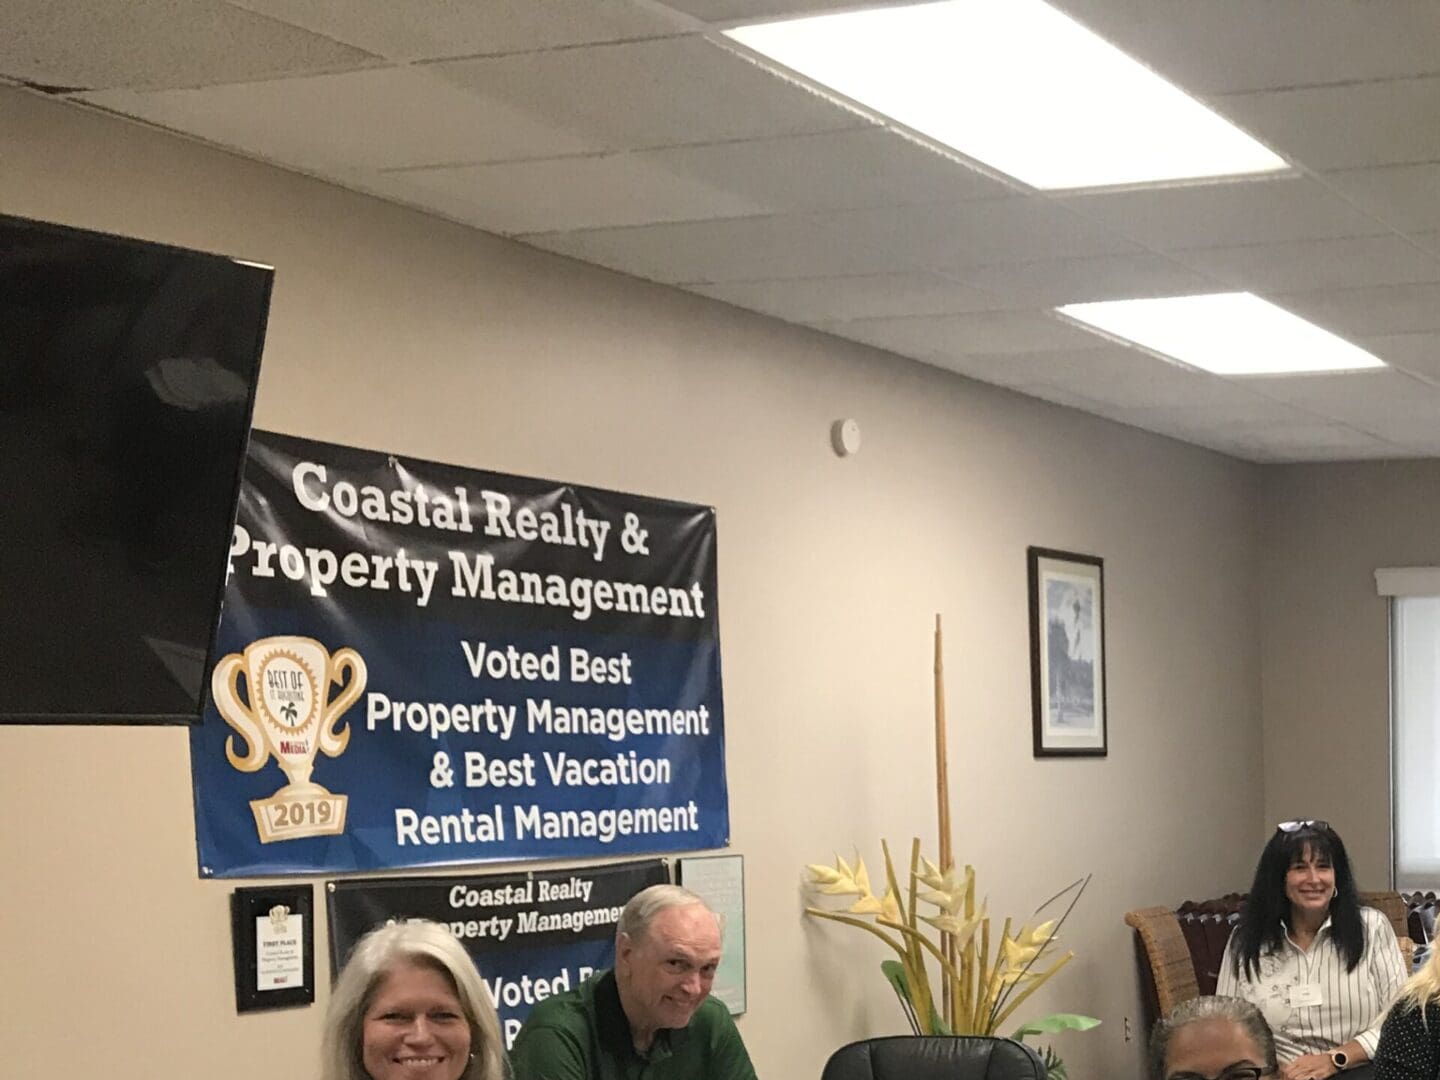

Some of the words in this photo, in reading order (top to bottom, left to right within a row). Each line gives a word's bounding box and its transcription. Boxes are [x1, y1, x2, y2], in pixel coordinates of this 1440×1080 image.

[292, 461, 474, 533] Coastal
[481, 489, 611, 562] Realty
[621, 512, 650, 556] &
[227, 524, 439, 607] Property
[448, 550, 705, 621] Management
[267, 669, 288, 689] BEST
[290, 670, 303, 690] OF
[460, 640, 560, 682] Voted
[570, 648, 632, 685] Best
[366, 692, 516, 741] Property
[527, 698, 710, 741] Management
[429, 751, 454, 788] &
[464, 751, 536, 788] Best
[543, 750, 671, 786] Vacation
[274, 801, 332, 826] 2019
[395, 804, 505, 846] Rental
[514, 801, 699, 842] Management
[449, 881, 533, 908] Coastal
[538, 877, 593, 902] Realty
[406, 916, 513, 941] perty
[517, 905, 626, 933] Manageme
